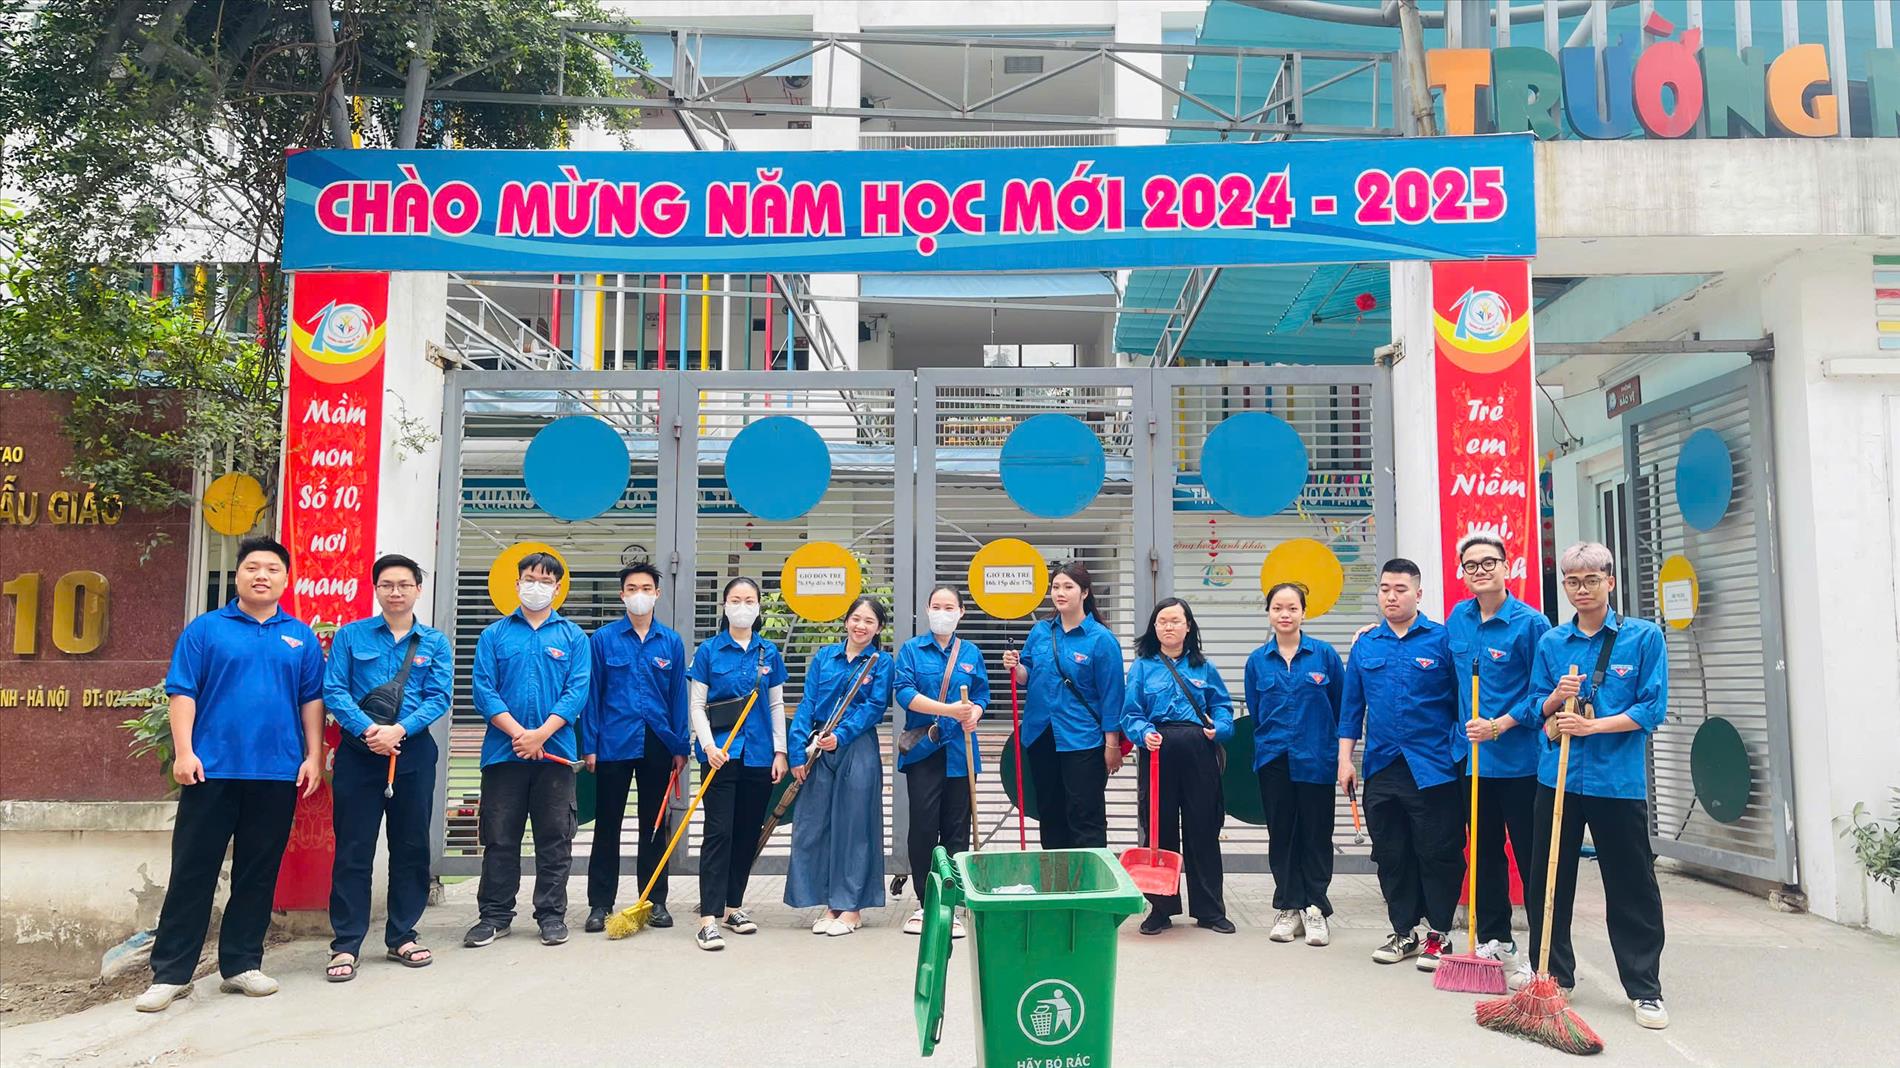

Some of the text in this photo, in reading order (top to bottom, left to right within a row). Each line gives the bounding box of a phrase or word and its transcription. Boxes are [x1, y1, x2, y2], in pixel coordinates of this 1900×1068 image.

[1426, 10, 1838, 139] TRƯỜNG
[316, 160, 1507, 256] CHÀO MỪNG NĂM HỌC MỚI 2024 - 2025
[303, 393, 366, 426] Mầm
[1467, 396, 1505, 421] Trẻ
[311, 447, 353, 467] non
[1466, 437, 1506, 457] em
[299, 479, 361, 512] Số 10,
[1450, 466, 1526, 498] Niềm
[48, 482, 124, 526] GIÁO
[310, 528, 347, 553] nơi
[294, 576, 358, 602] mang
[3, 570, 110, 655] 10
[27, 685, 45, 708] HÀ
[47, 685, 70, 712] NỘI
[83, 688, 103, 708] ĐT:
[1066, 1053, 1091, 1068] RÁC
